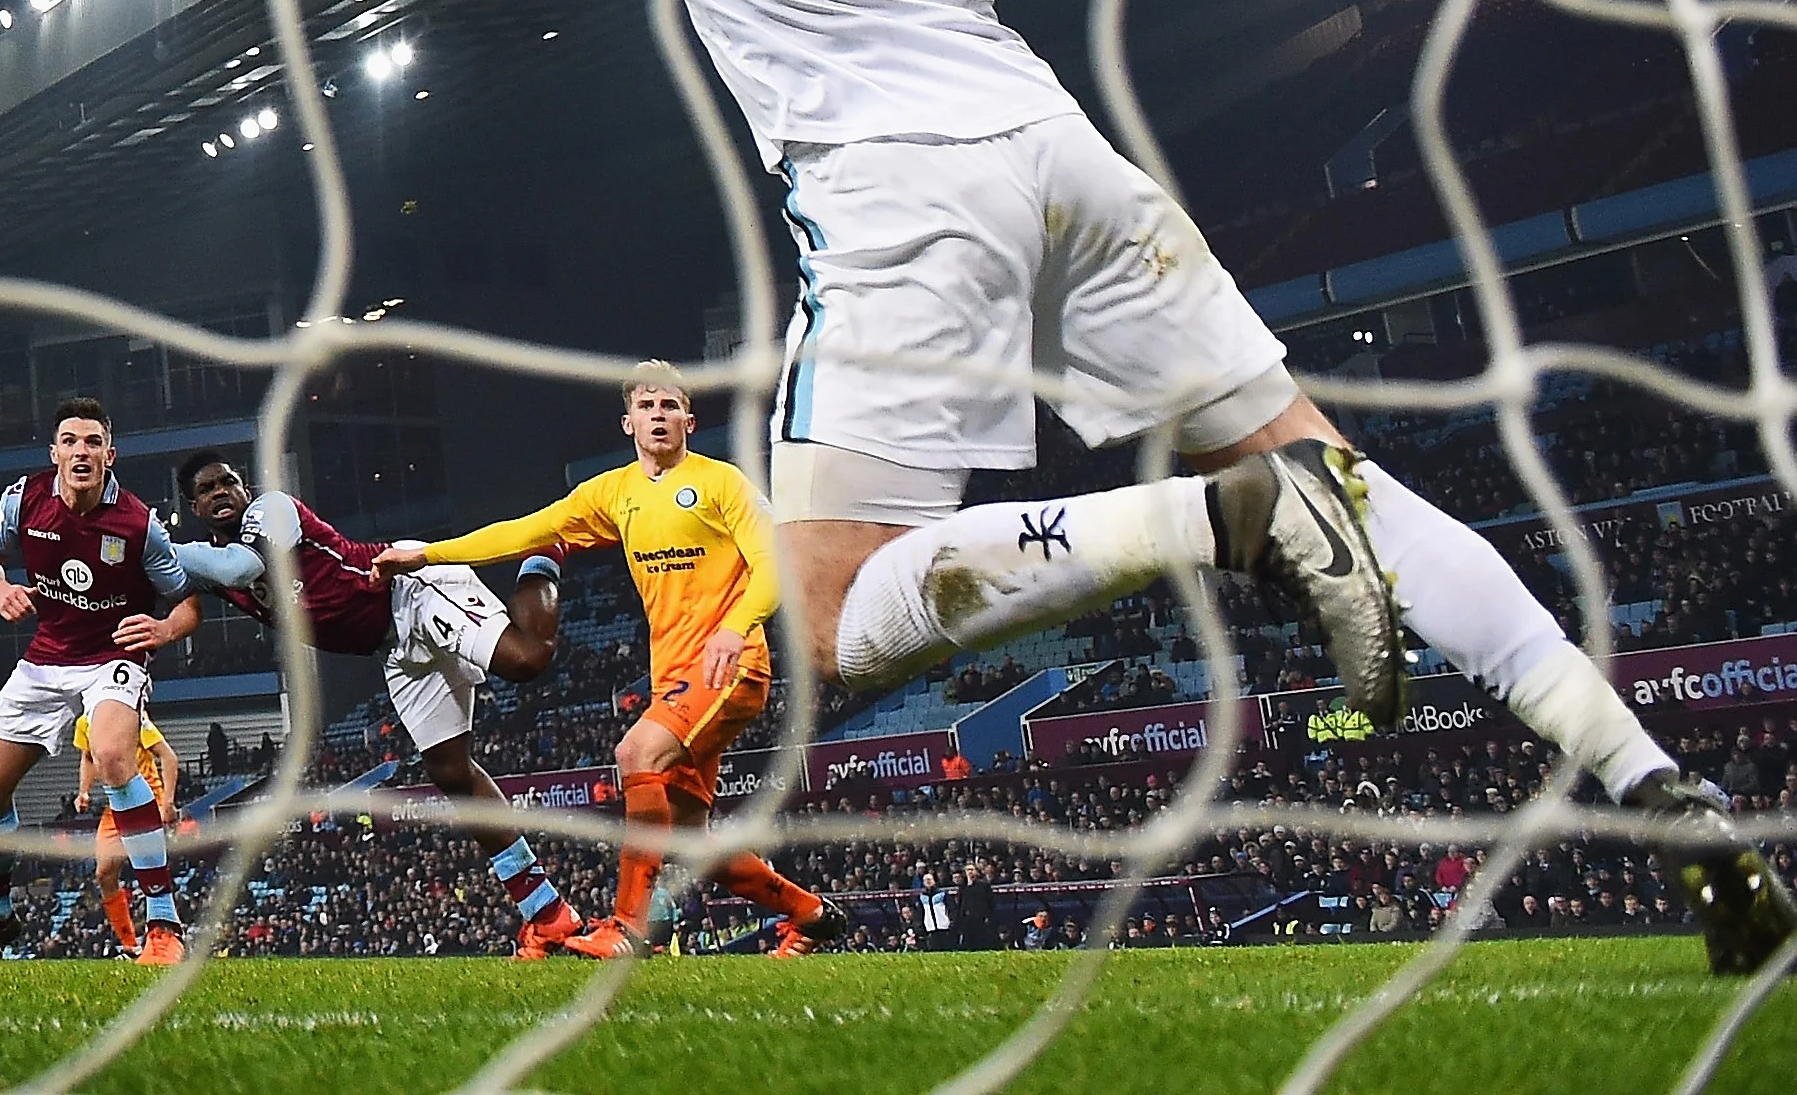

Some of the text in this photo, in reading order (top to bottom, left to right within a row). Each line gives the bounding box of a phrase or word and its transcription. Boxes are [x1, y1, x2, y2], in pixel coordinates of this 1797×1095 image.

[36, 581, 128, 612] QuickBooks
[432, 614, 454, 640] 4
[112, 662, 130, 686] 6
[1633, 656, 1797, 705] avfcofficia
[512, 782, 590, 810] avfofficial
